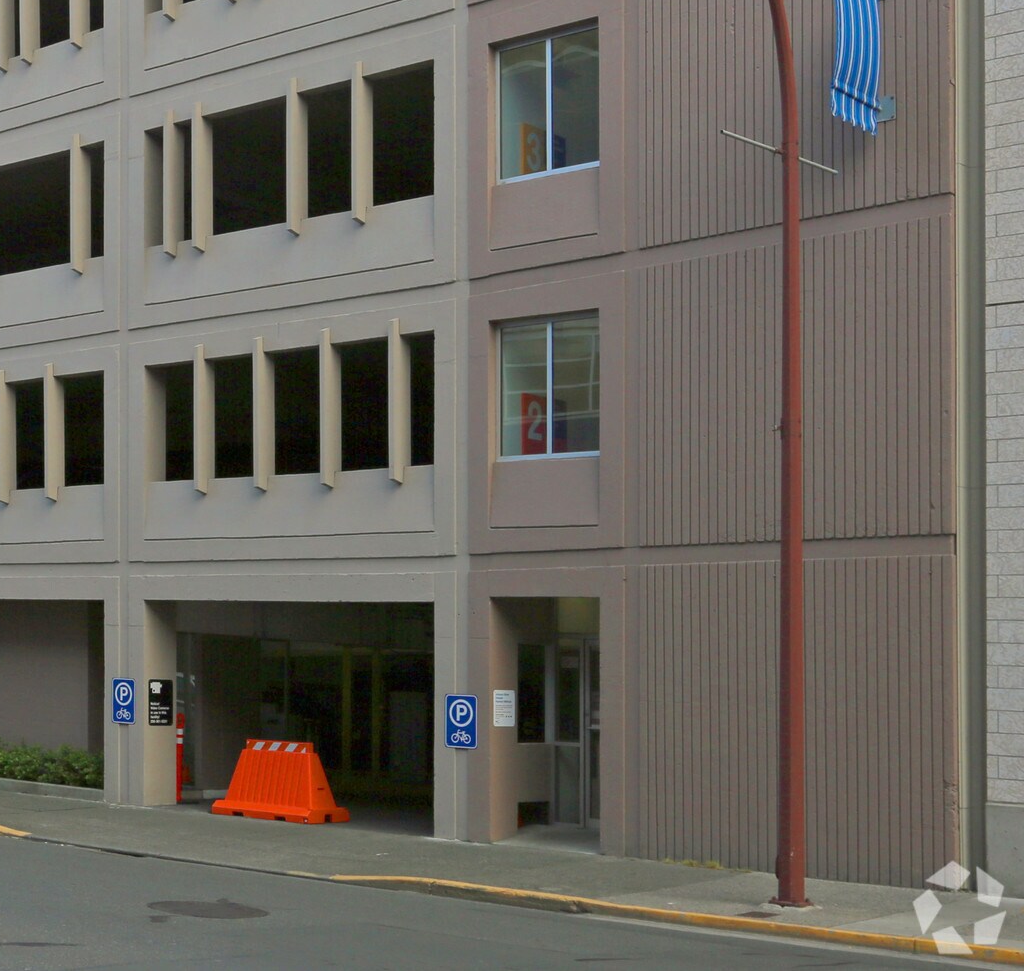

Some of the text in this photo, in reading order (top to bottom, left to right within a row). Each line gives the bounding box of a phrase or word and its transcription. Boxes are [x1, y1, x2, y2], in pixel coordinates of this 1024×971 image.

[527, 132, 541, 170] 3
[527, 400, 543, 440] 2
[120, 686, 129, 701] P
[456, 704, 468, 722] P
